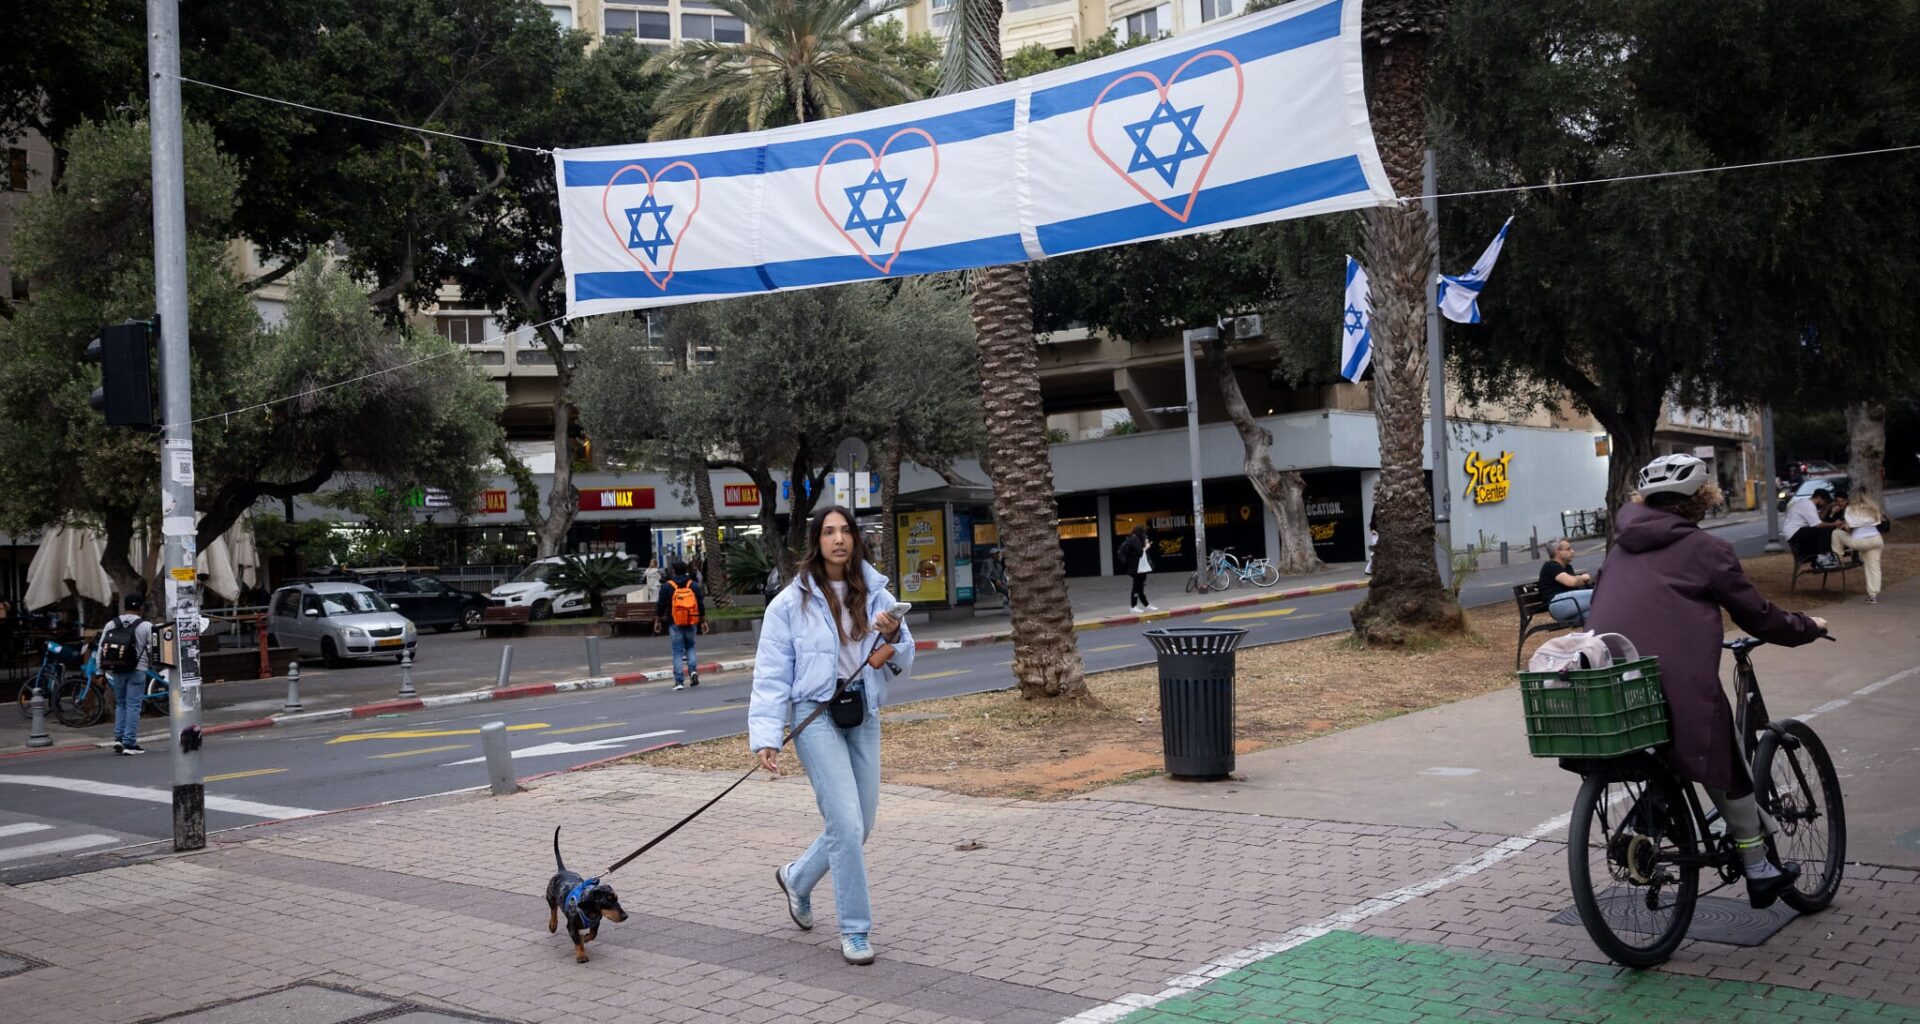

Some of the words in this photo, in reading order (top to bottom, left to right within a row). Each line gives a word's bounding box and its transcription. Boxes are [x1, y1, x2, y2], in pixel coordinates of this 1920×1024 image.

[1465, 451, 1514, 496] Street
[616, 491, 633, 507] MAX
[741, 487, 758, 502] MAX
[1479, 485, 1507, 501] Center
[487, 494, 505, 509] MAX
[1306, 502, 1345, 516] OCATION.
